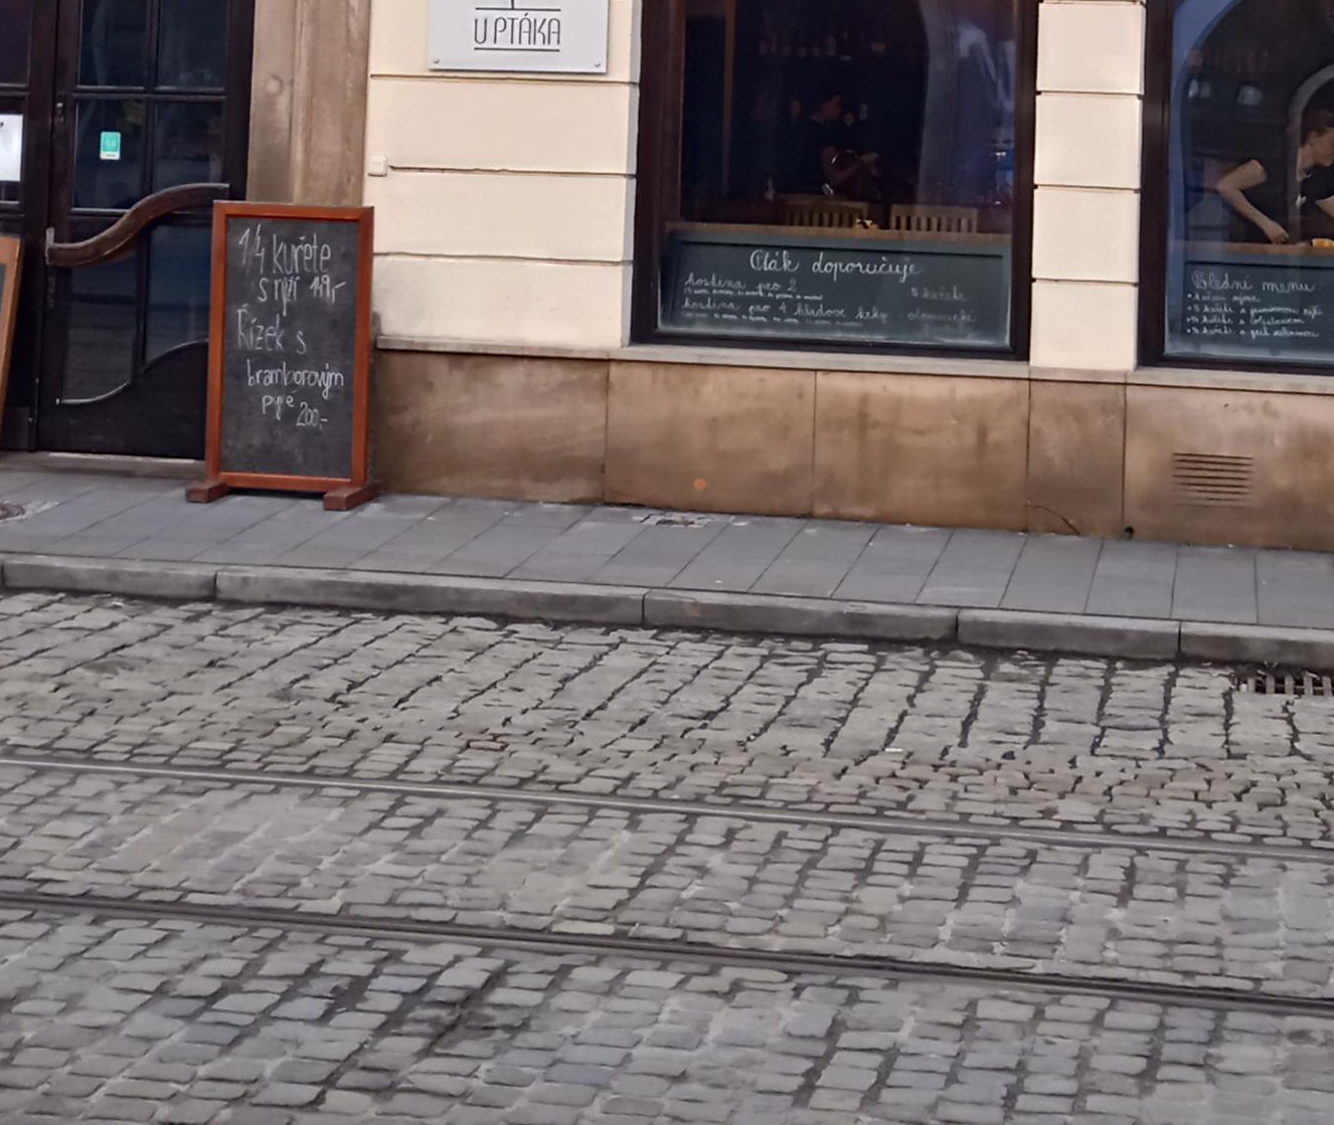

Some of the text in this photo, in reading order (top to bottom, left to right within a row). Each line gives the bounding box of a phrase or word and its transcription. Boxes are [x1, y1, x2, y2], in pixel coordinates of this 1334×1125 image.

[474, 12, 562, 46] U PTÁKA
[271, 232, 331, 275] kuřete
[258, 276, 269, 303] s
[787, 277, 798, 292] 2
[1261, 281, 1315, 293] menu
[778, 301, 787, 314] 4
